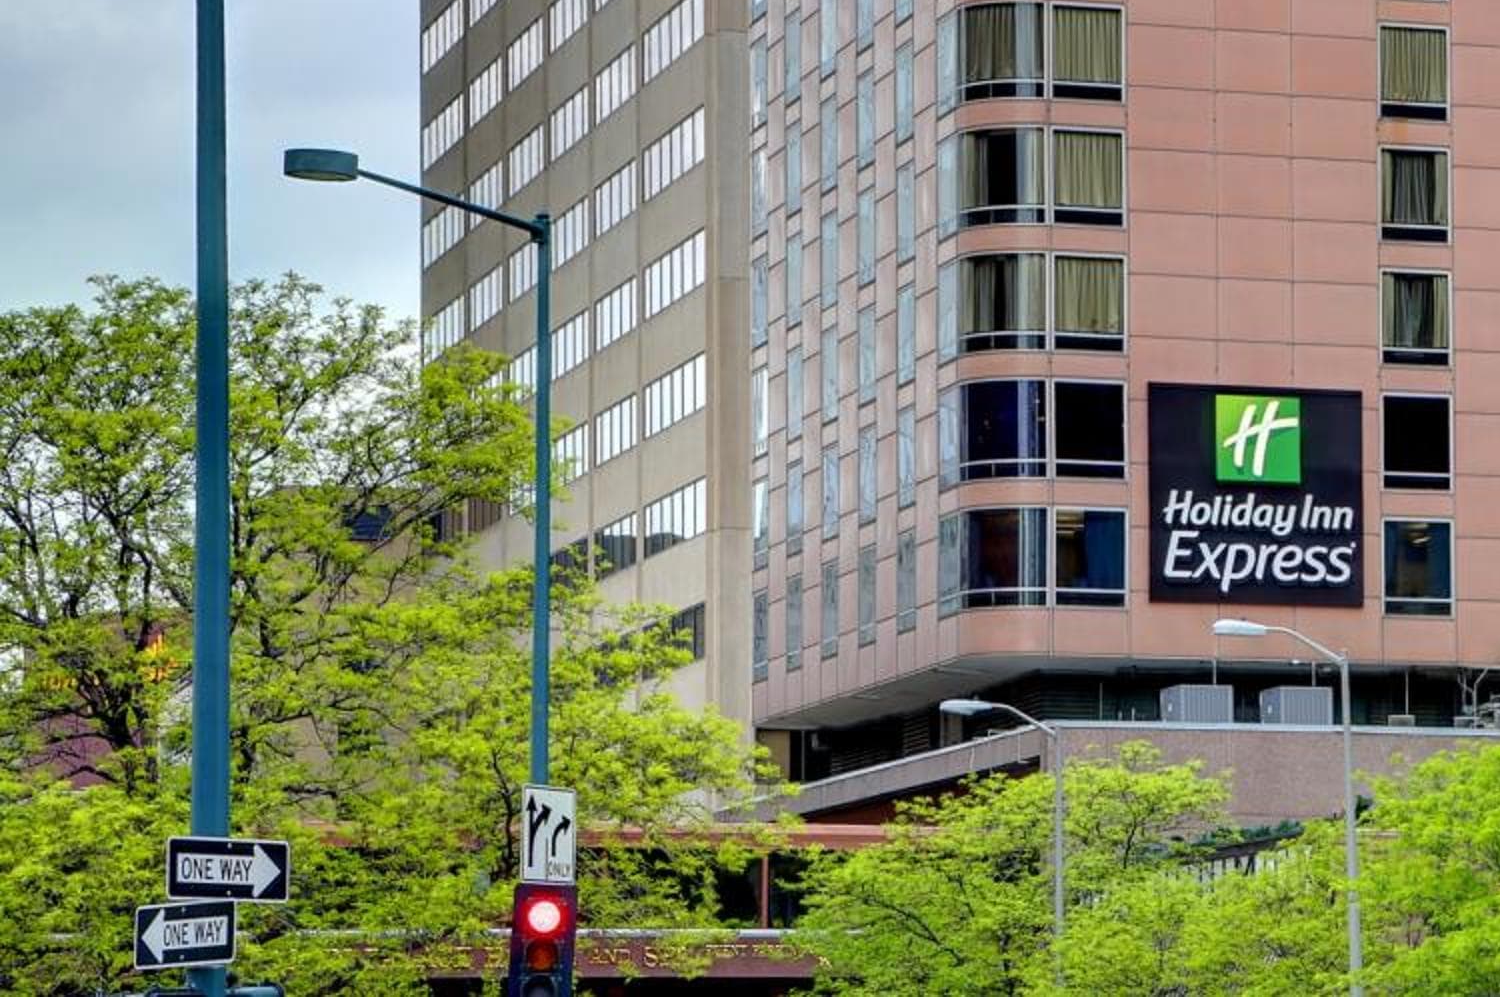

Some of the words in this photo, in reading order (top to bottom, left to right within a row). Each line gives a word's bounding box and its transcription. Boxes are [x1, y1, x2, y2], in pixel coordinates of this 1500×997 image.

[1163, 489, 1297, 536] Holiday
[1301, 494, 1354, 530] Inn
[1163, 530, 1353, 593] Express
[181, 856, 215, 880] ONE
[219, 858, 253, 882] WAY
[163, 922, 190, 947] ONE
[193, 918, 224, 943] WAY
